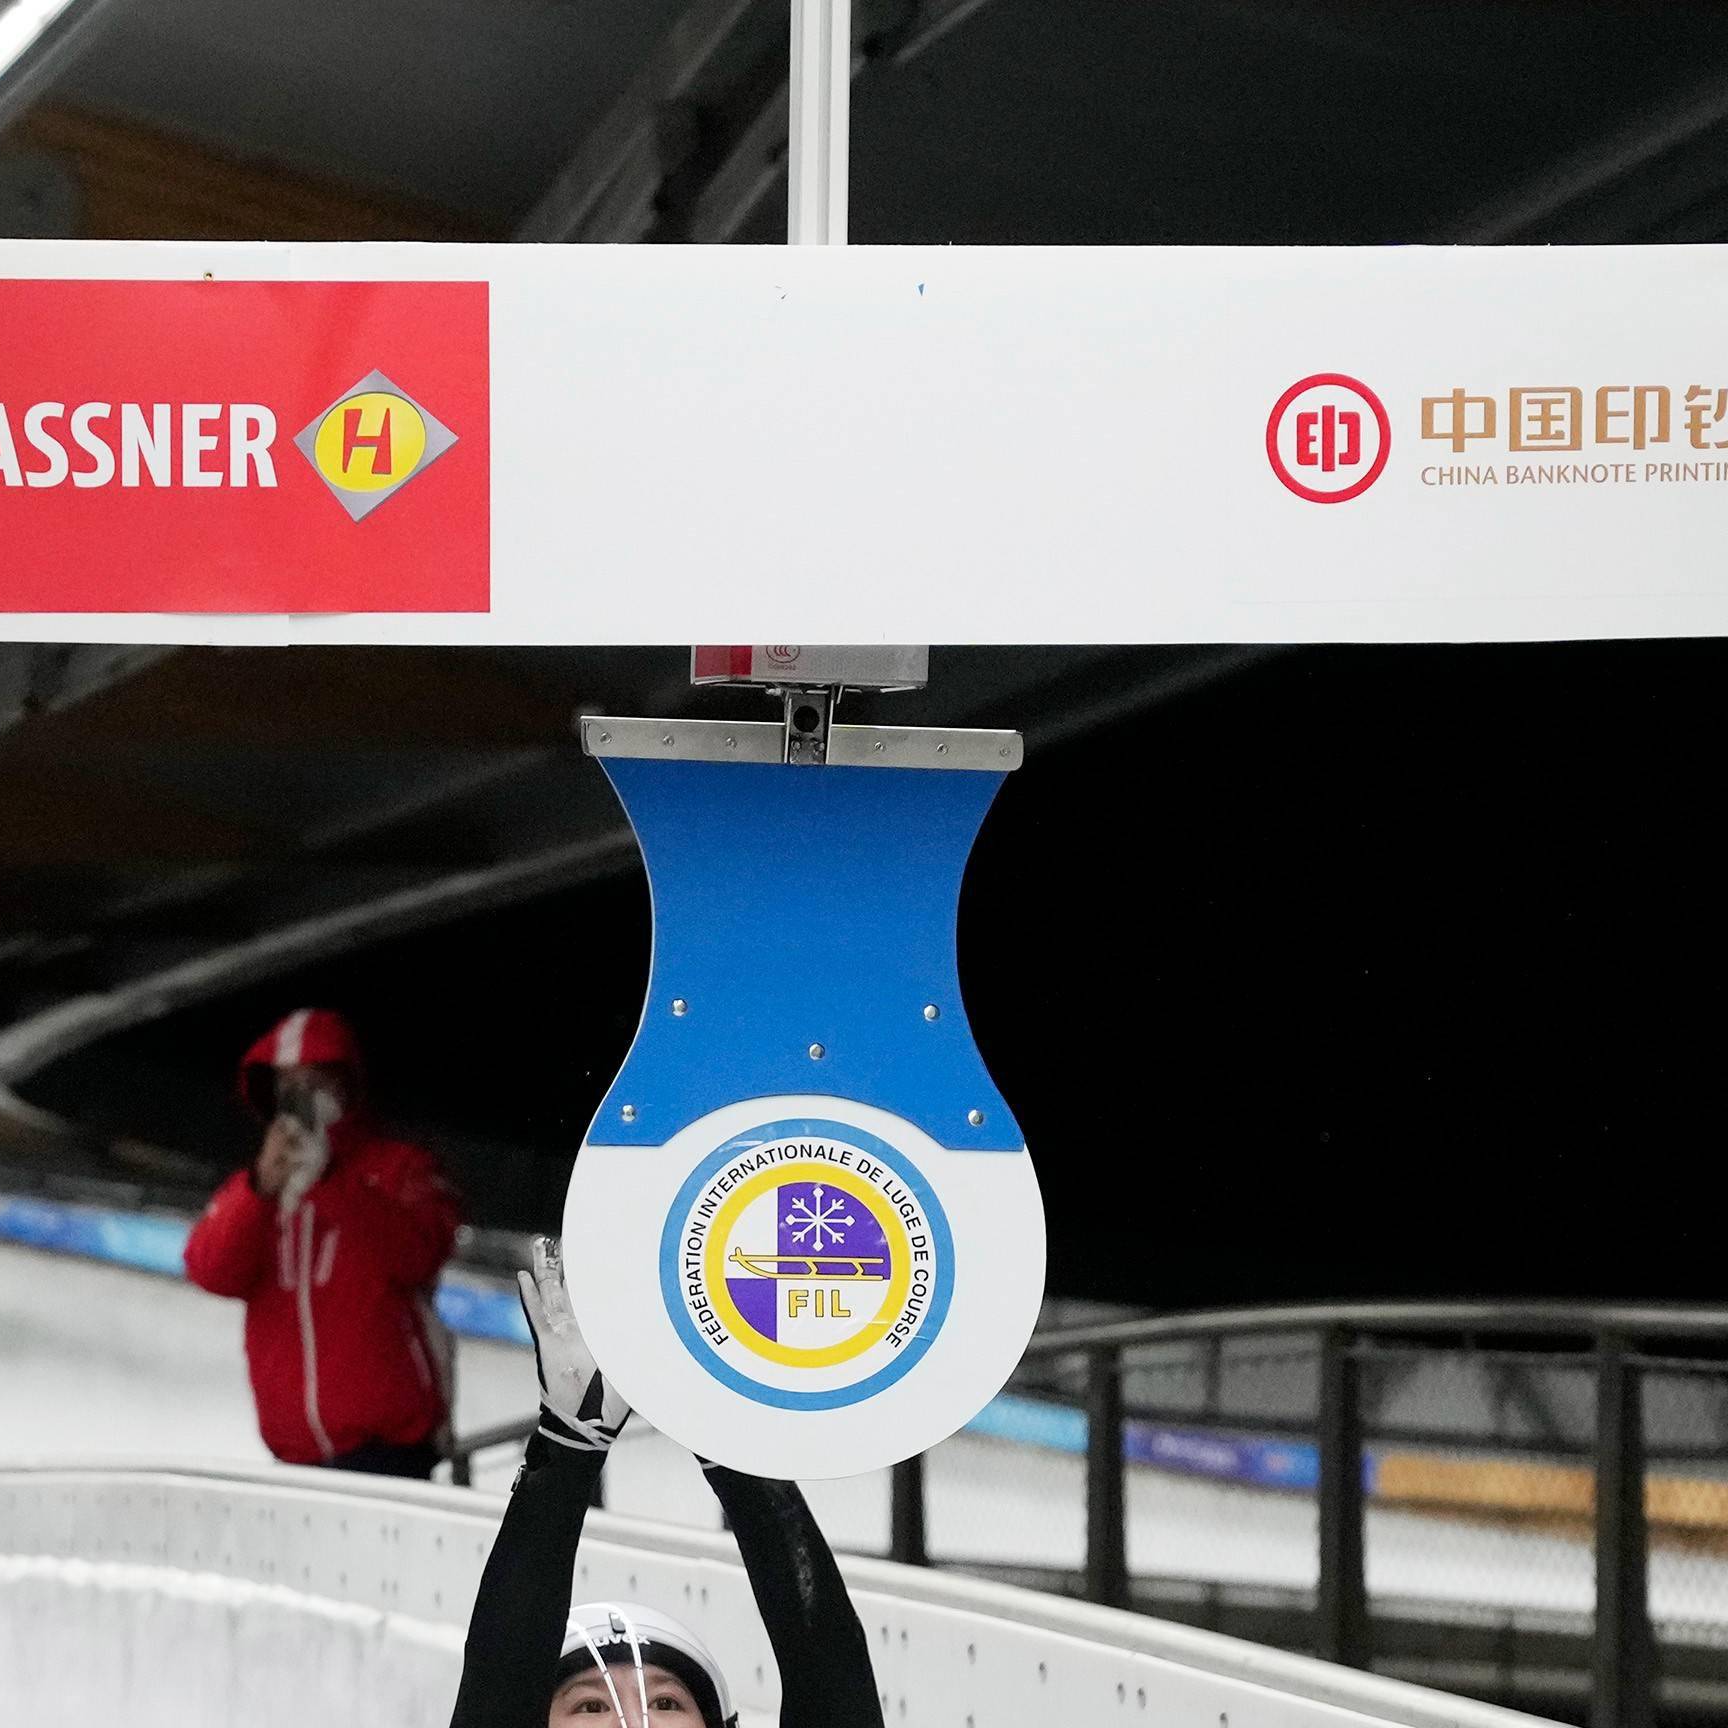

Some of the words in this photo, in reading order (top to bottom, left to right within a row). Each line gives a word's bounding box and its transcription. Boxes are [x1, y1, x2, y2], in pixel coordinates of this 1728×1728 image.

[1421, 466, 1499, 486] CHINA
[1505, 463, 1638, 485] BANKNOTE
[701, 1144, 853, 1219] INTERNATIONALE
[856, 1158, 884, 1184] DE
[882, 1179, 922, 1230] LUGE
[911, 1234, 930, 1262] DE
[686, 1218, 729, 1346] FÉDÉRATION
[788, 1289, 852, 1318] FIL
[885, 1269, 930, 1348] COURSE
